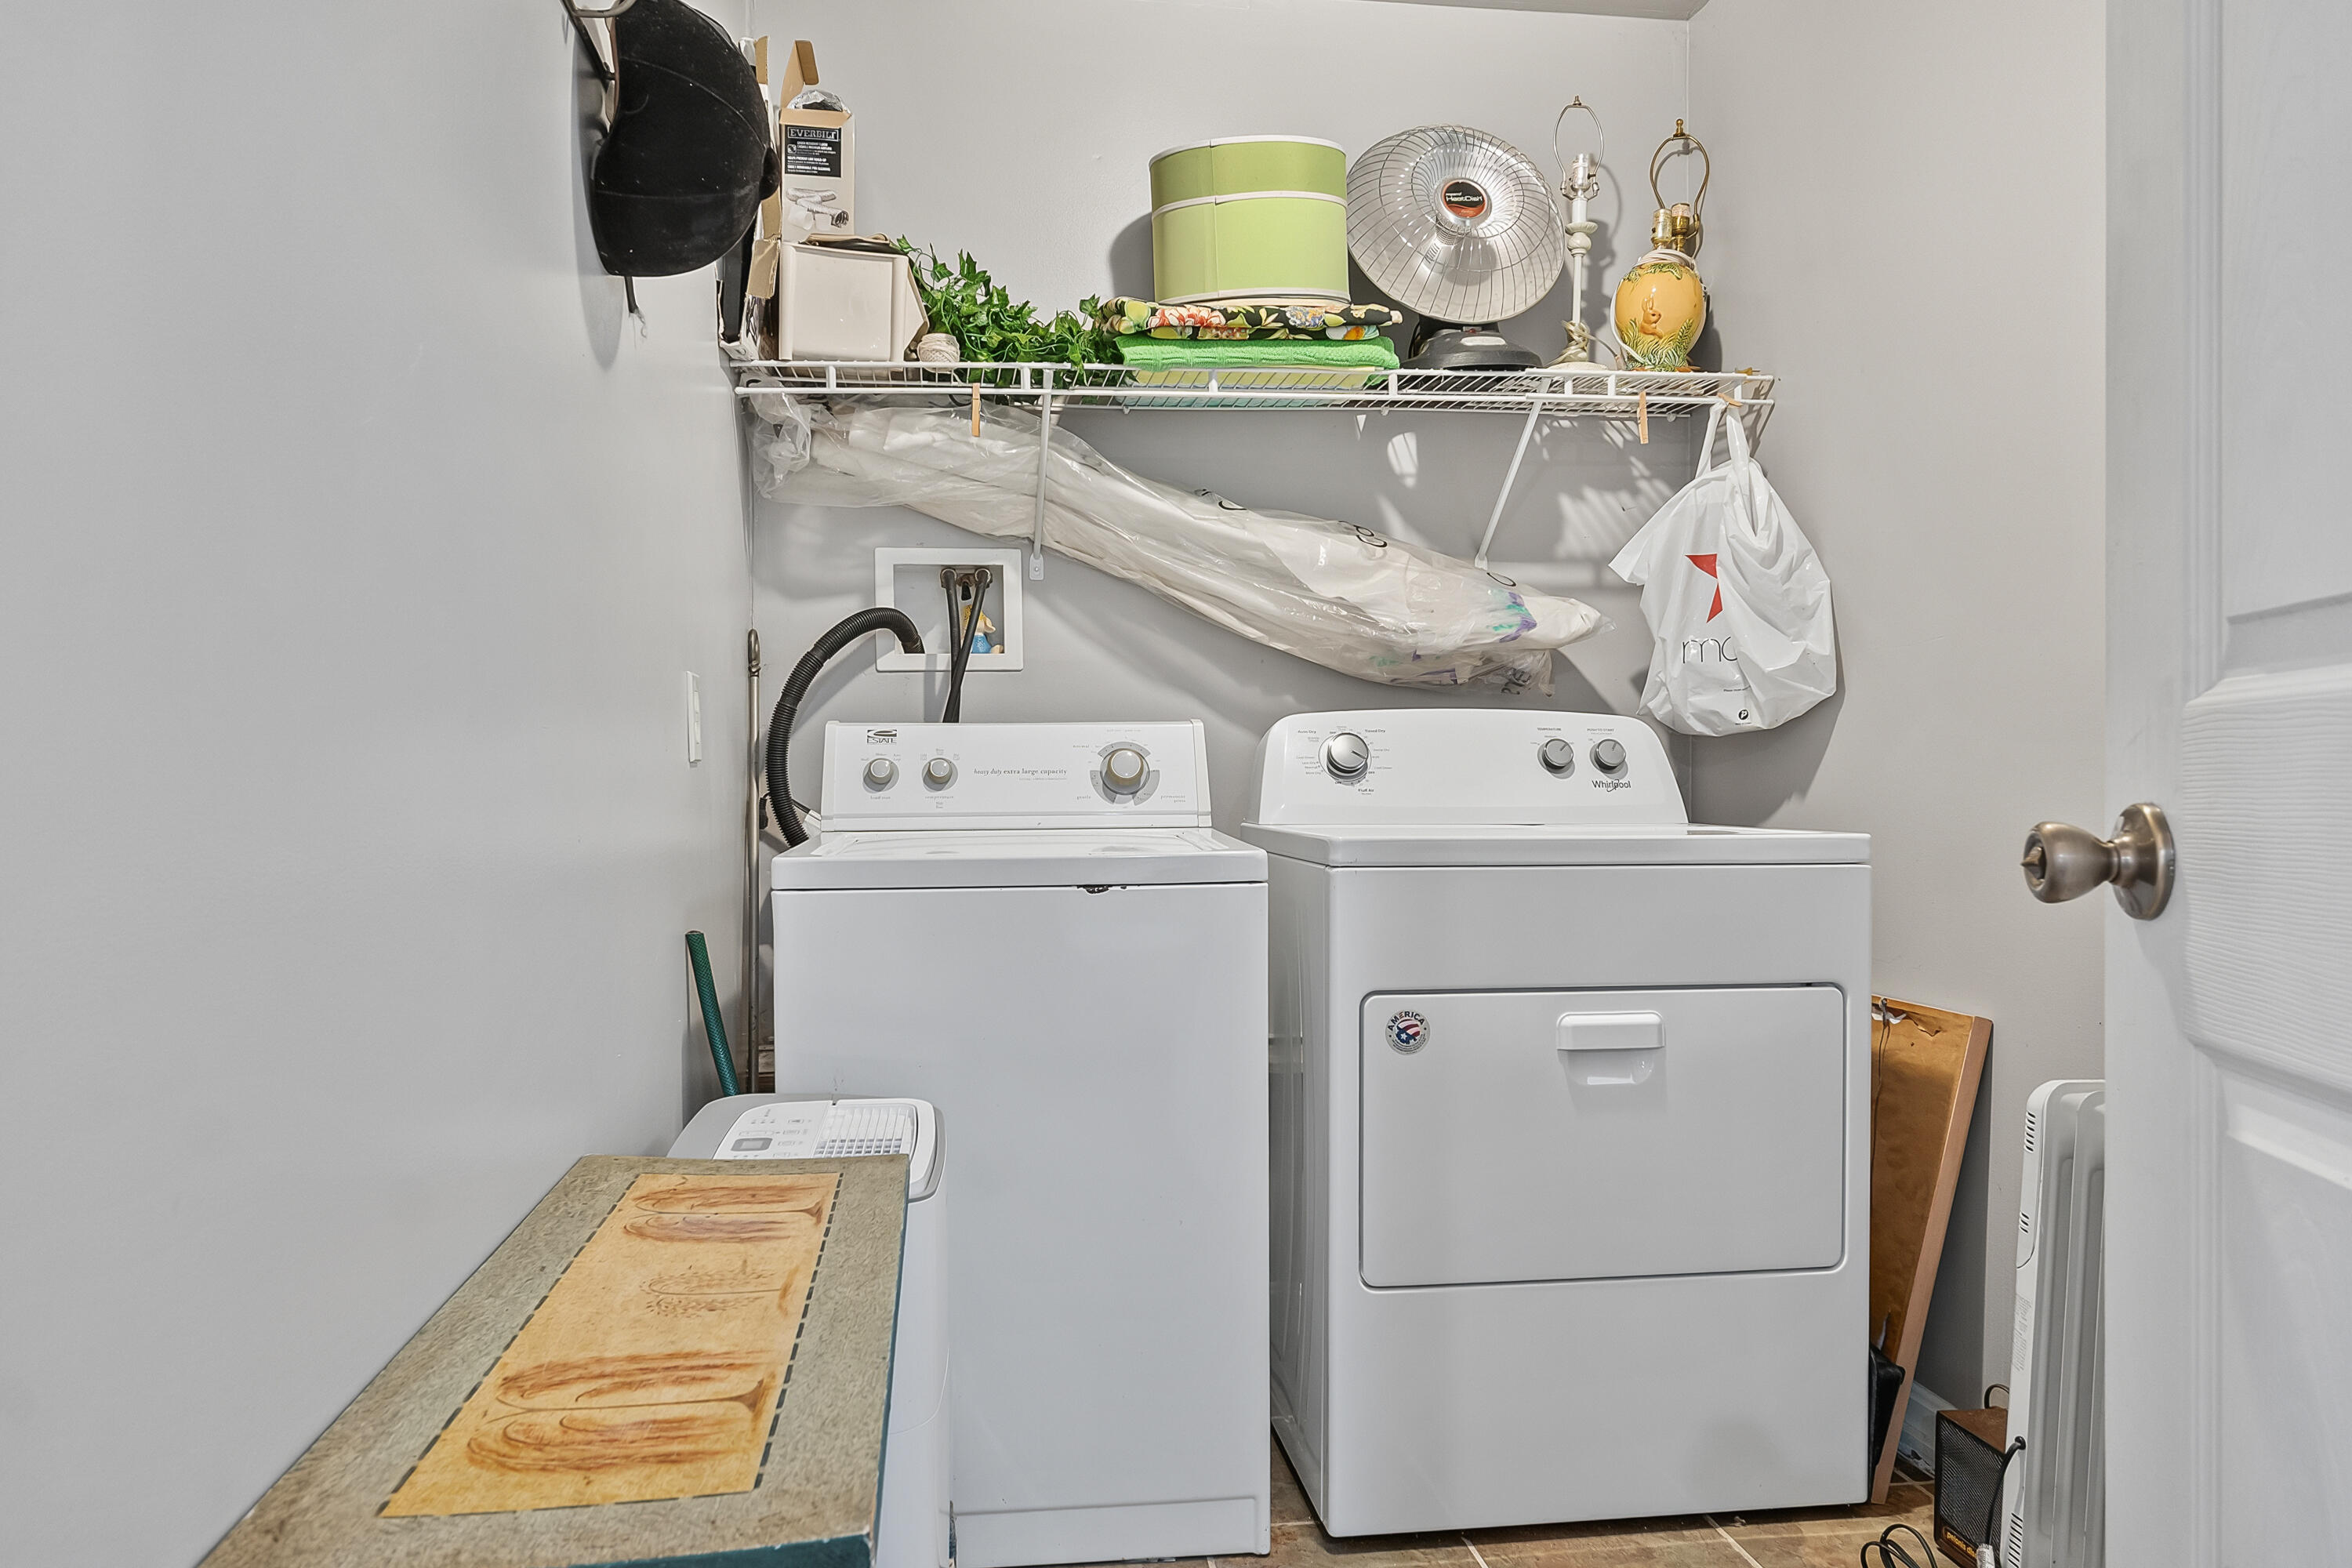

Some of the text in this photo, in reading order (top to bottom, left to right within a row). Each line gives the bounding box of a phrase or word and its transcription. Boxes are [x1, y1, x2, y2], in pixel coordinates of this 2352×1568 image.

[790, 129, 837, 139] EVERBILT
[1592, 779, 1631, 792] Whirlpool
[1387, 1011, 1425, 1032] AMERICA
[1947, 1531, 1966, 1551] pelonis
